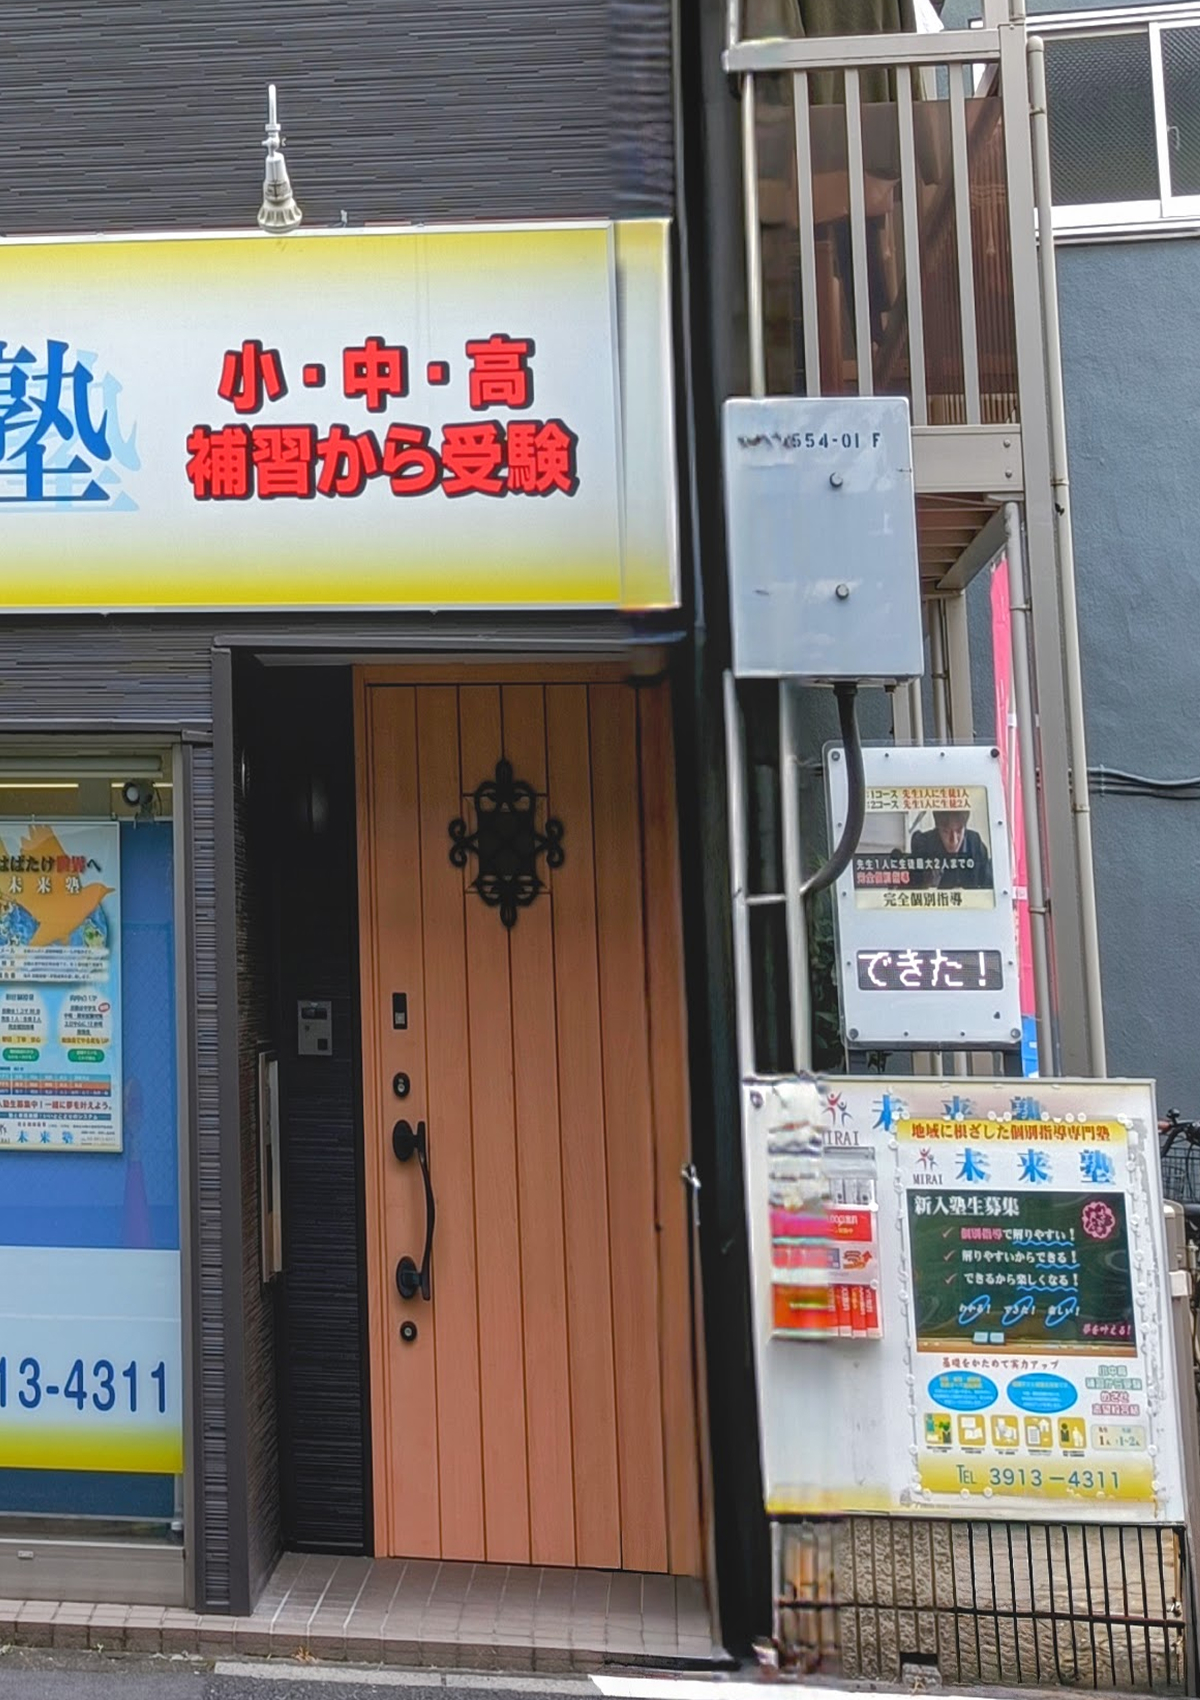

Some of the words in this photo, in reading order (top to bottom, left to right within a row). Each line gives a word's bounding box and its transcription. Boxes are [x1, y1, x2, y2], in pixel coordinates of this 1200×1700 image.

[217, 333, 536, 416] 小・中・高
[186, 419, 580, 501] 補習から受験
[883, 892, 962, 907] 完全個別指導
[858, 949, 988, 987] できた！
[911, 1123, 1111, 1142] 地域に根ざした個別指導専門塾
[955, 1147, 1113, 1184] 未来塾
[913, 1174, 944, 1186] MIRAI
[914, 1195, 1020, 1216] 新入塾生募集
[956, 1464, 977, 1485] TEL
